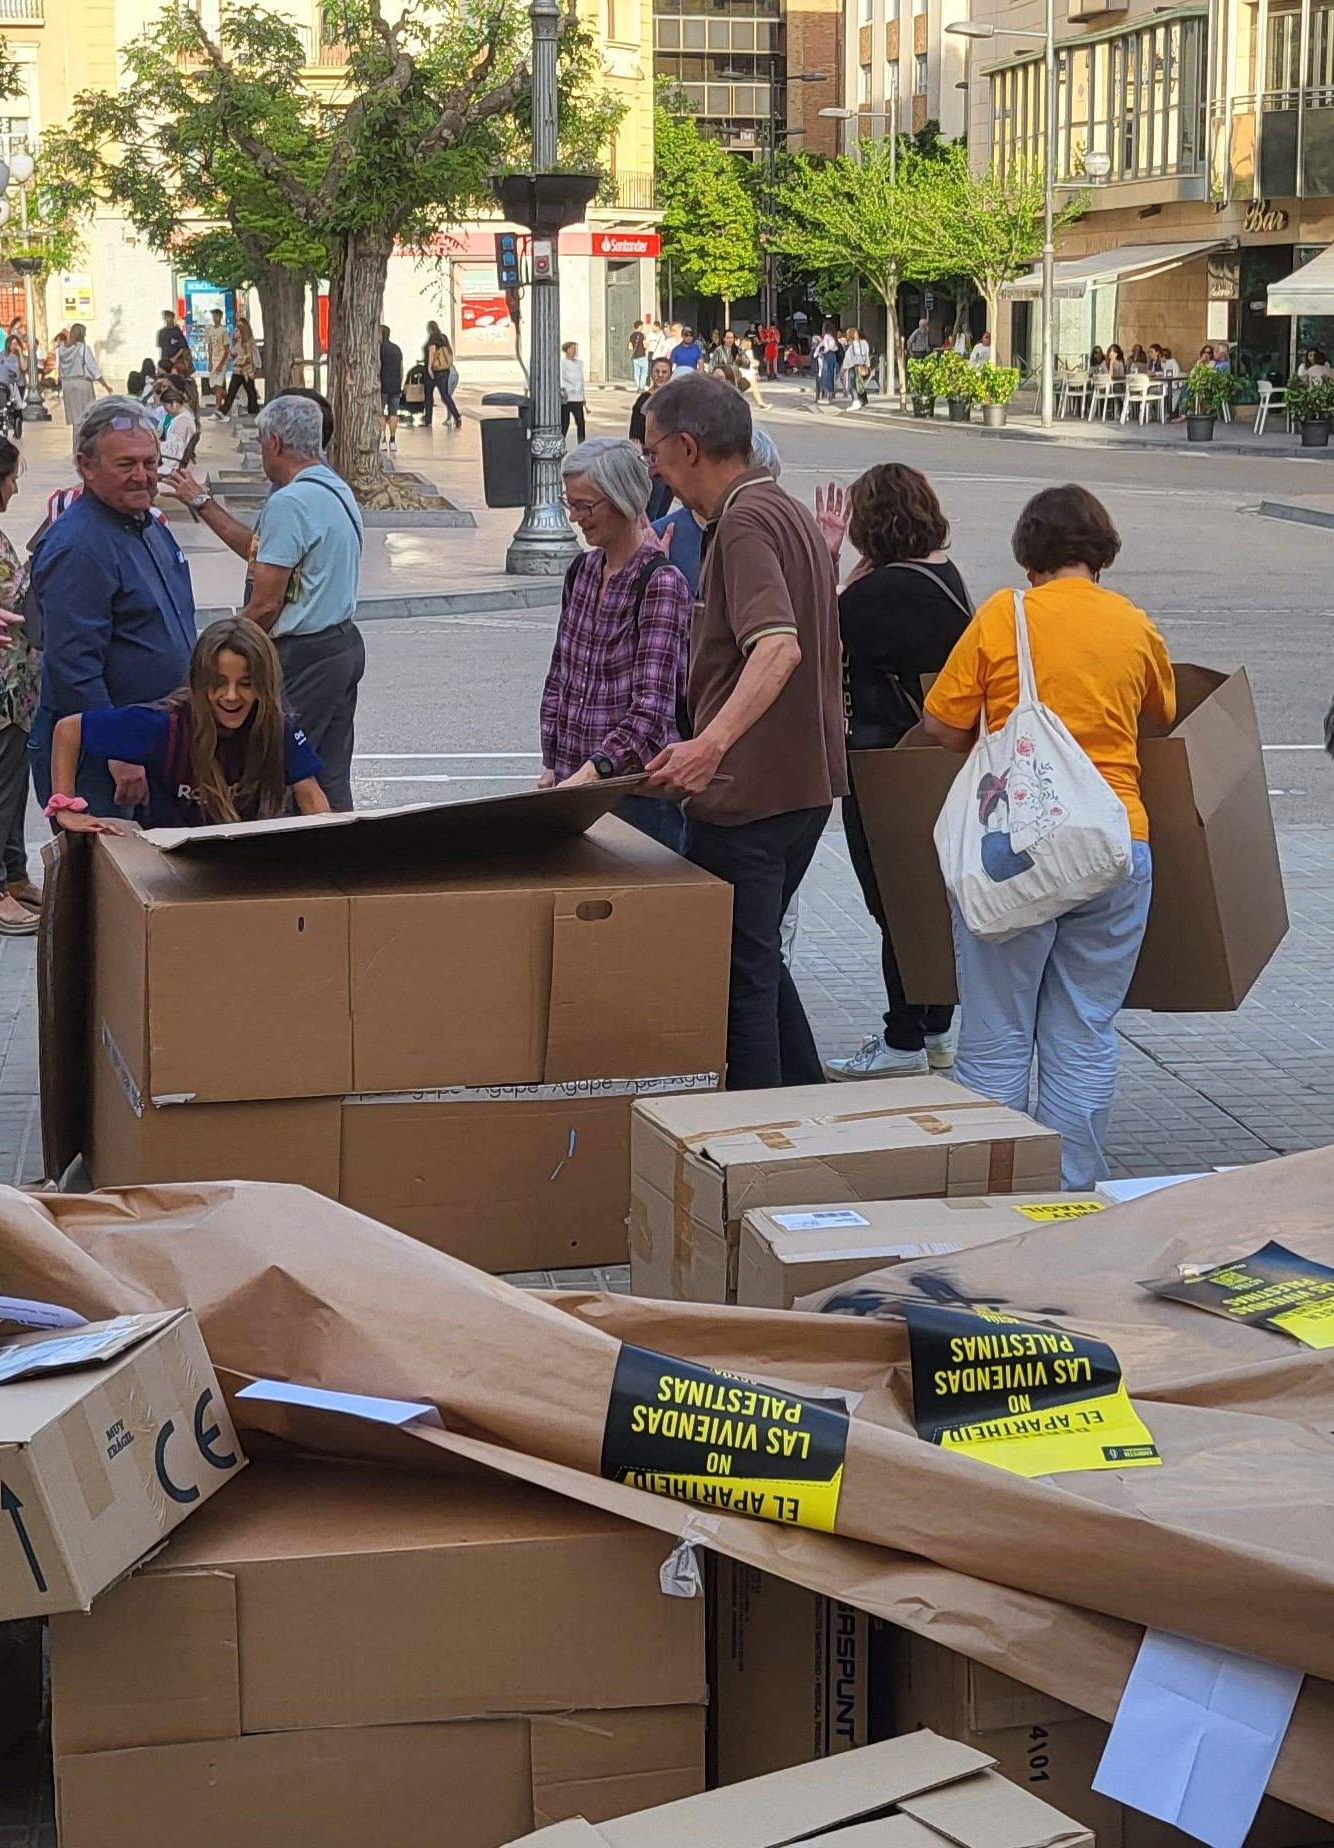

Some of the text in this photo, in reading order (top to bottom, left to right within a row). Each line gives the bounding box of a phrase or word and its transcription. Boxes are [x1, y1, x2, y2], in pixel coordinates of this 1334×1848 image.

[1243, 199, 1288, 232] Bar
[610, 241, 648, 253] Santander
[950, 1333, 1075, 1363] PALESTINAS
[934, 1357, 1092, 1396] LAS VIVIENDAS
[657, 1375, 802, 1424] PALESTINAS
[1007, 1393, 1031, 1413] NO
[105, 1419, 126, 1442] MUY
[631, 1404, 811, 1458] LAS VIVIENDAS
[949, 1409, 1104, 1443] EL APARTHEID
[106, 1430, 135, 1461] FRÁGIL
[155, 1387, 238, 1504] CE
[706, 1451, 732, 1475] NO
[632, 1473, 799, 1521] EL APARTHEID
